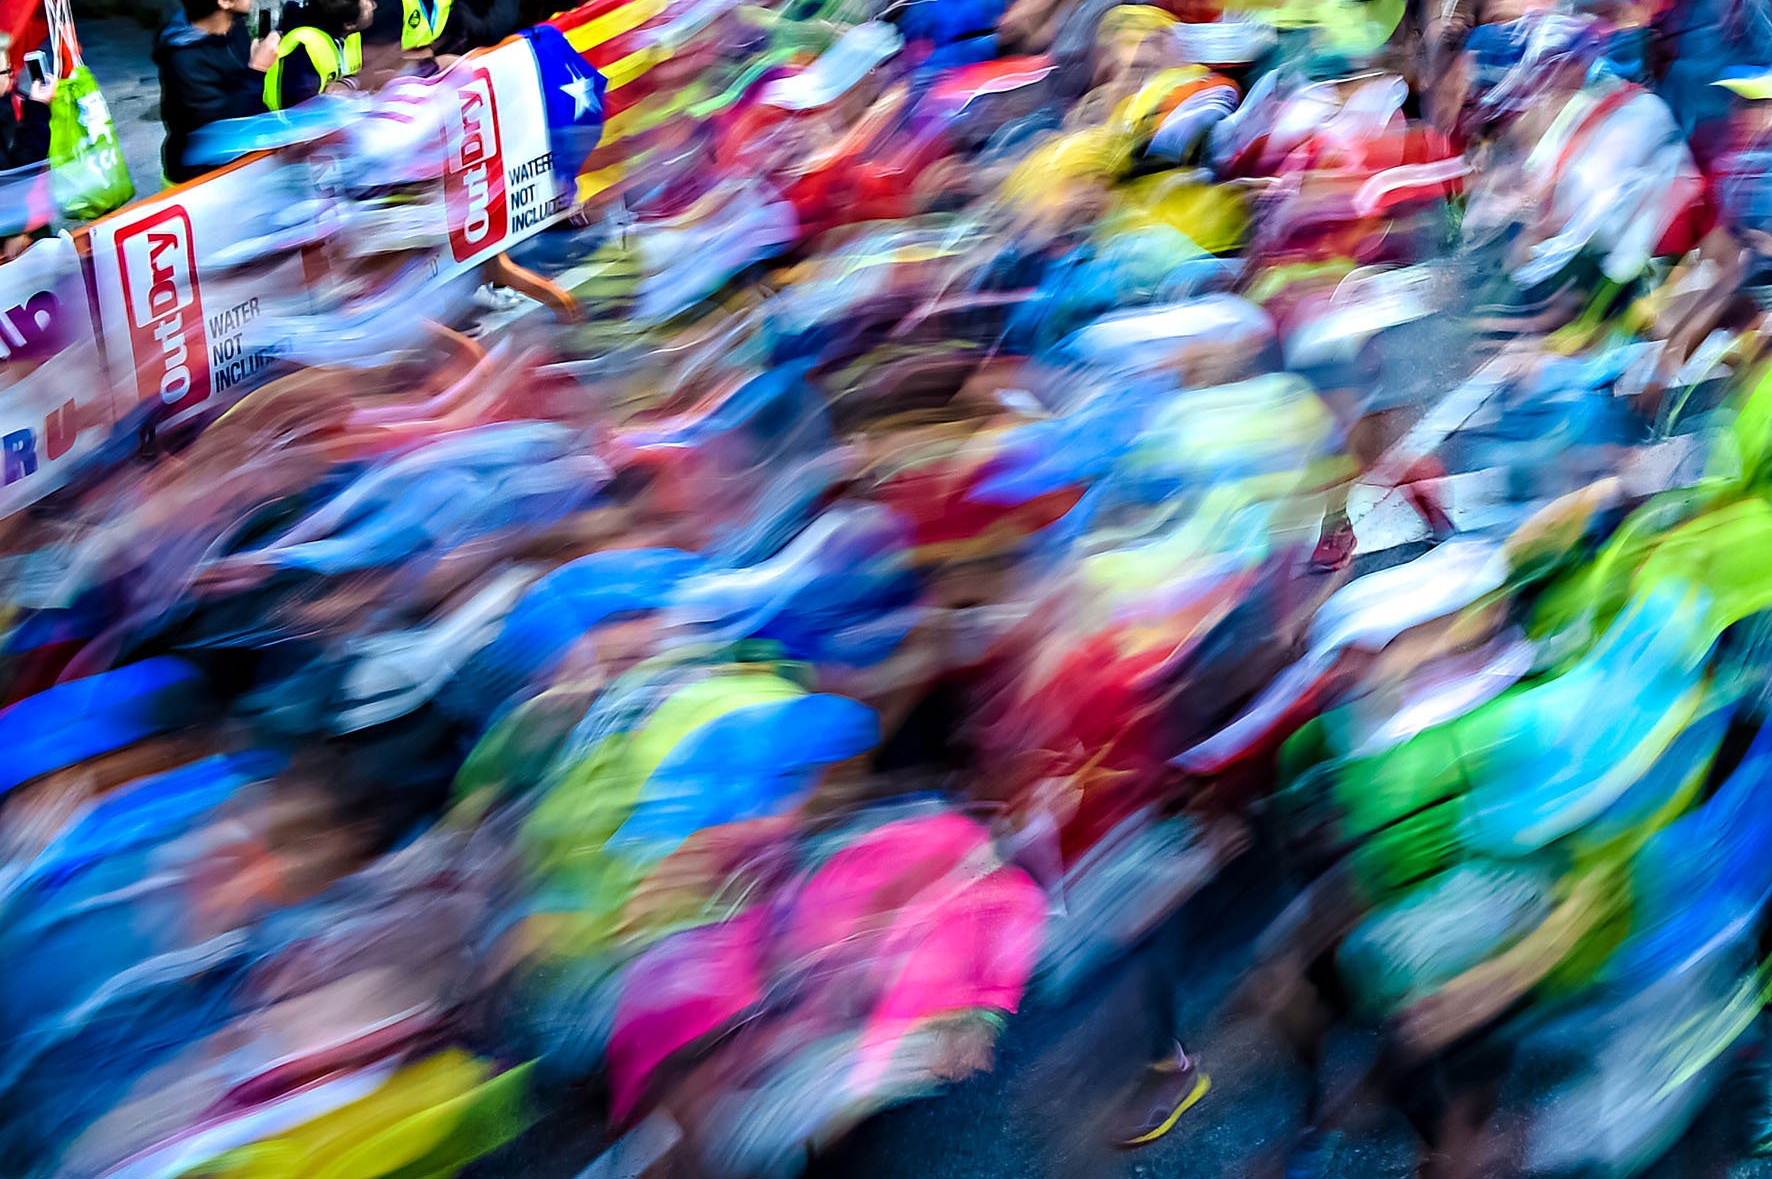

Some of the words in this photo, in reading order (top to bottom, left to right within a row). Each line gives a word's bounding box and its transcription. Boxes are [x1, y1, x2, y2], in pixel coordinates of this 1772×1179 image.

[511, 184, 536, 211] NOT
[512, 191, 571, 234] INCLUDE
[147, 232, 192, 405] OutDry
[209, 297, 260, 339] WATER
[213, 332, 243, 367] NOT
